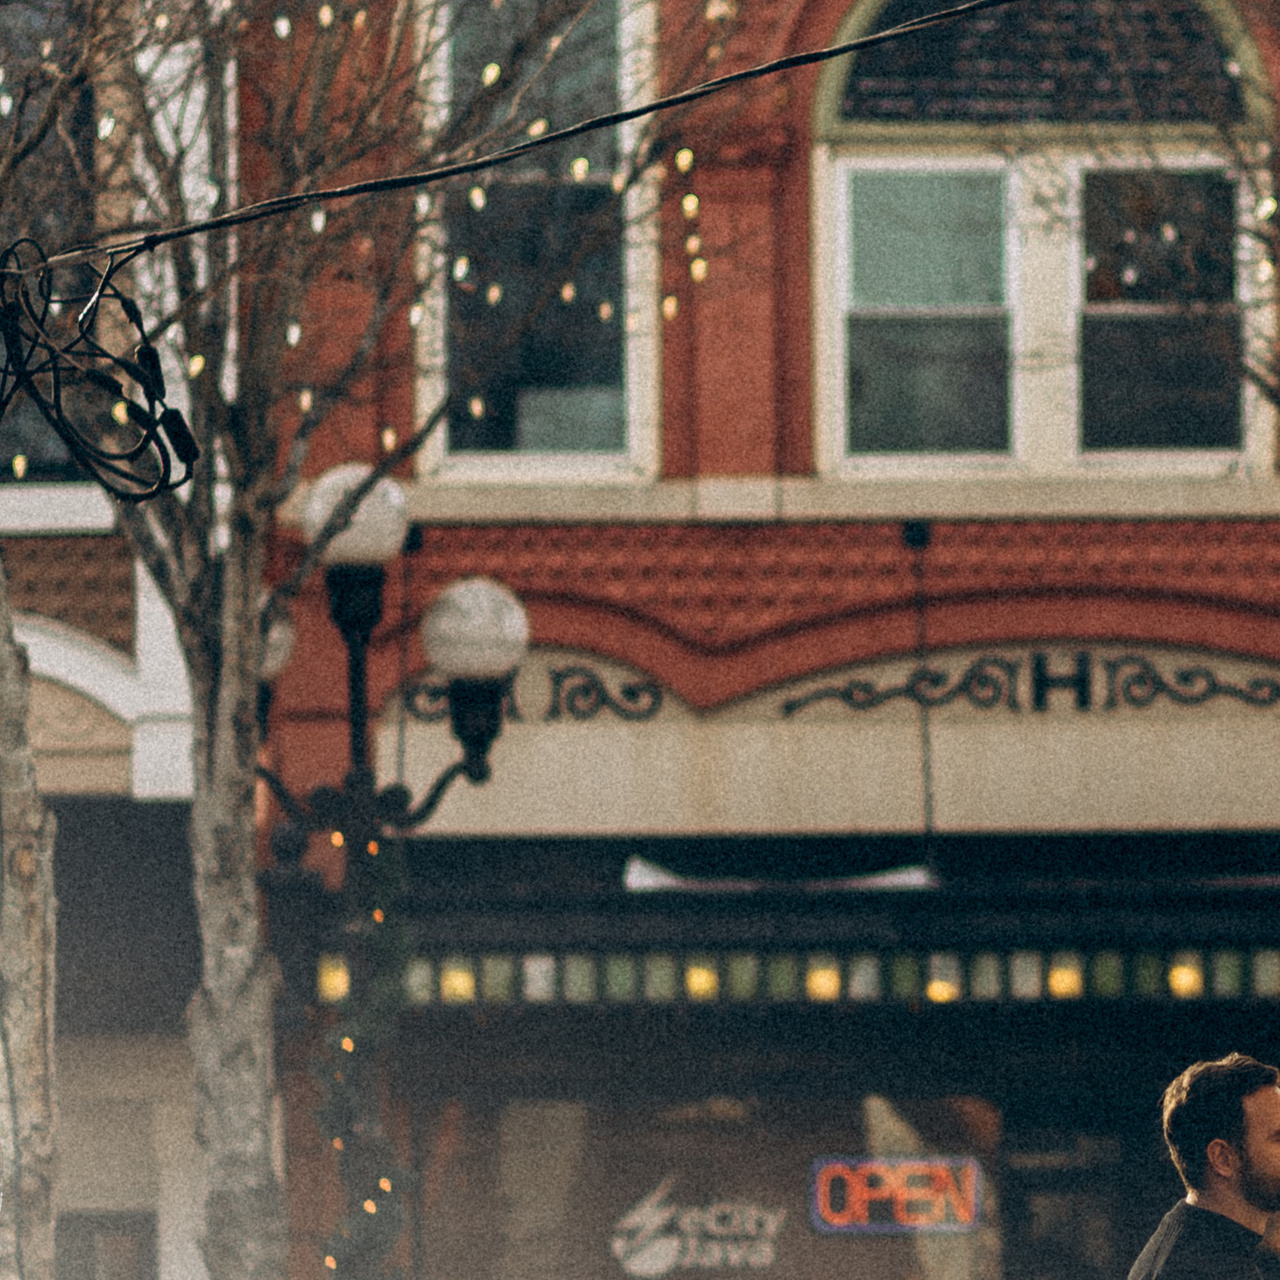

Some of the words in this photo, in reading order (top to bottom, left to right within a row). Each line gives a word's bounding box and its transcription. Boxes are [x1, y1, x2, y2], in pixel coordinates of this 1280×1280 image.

[1032, 651, 1091, 712] H
[817, 1162, 977, 1227] OPEN
[679, 1236, 775, 1269] Java
